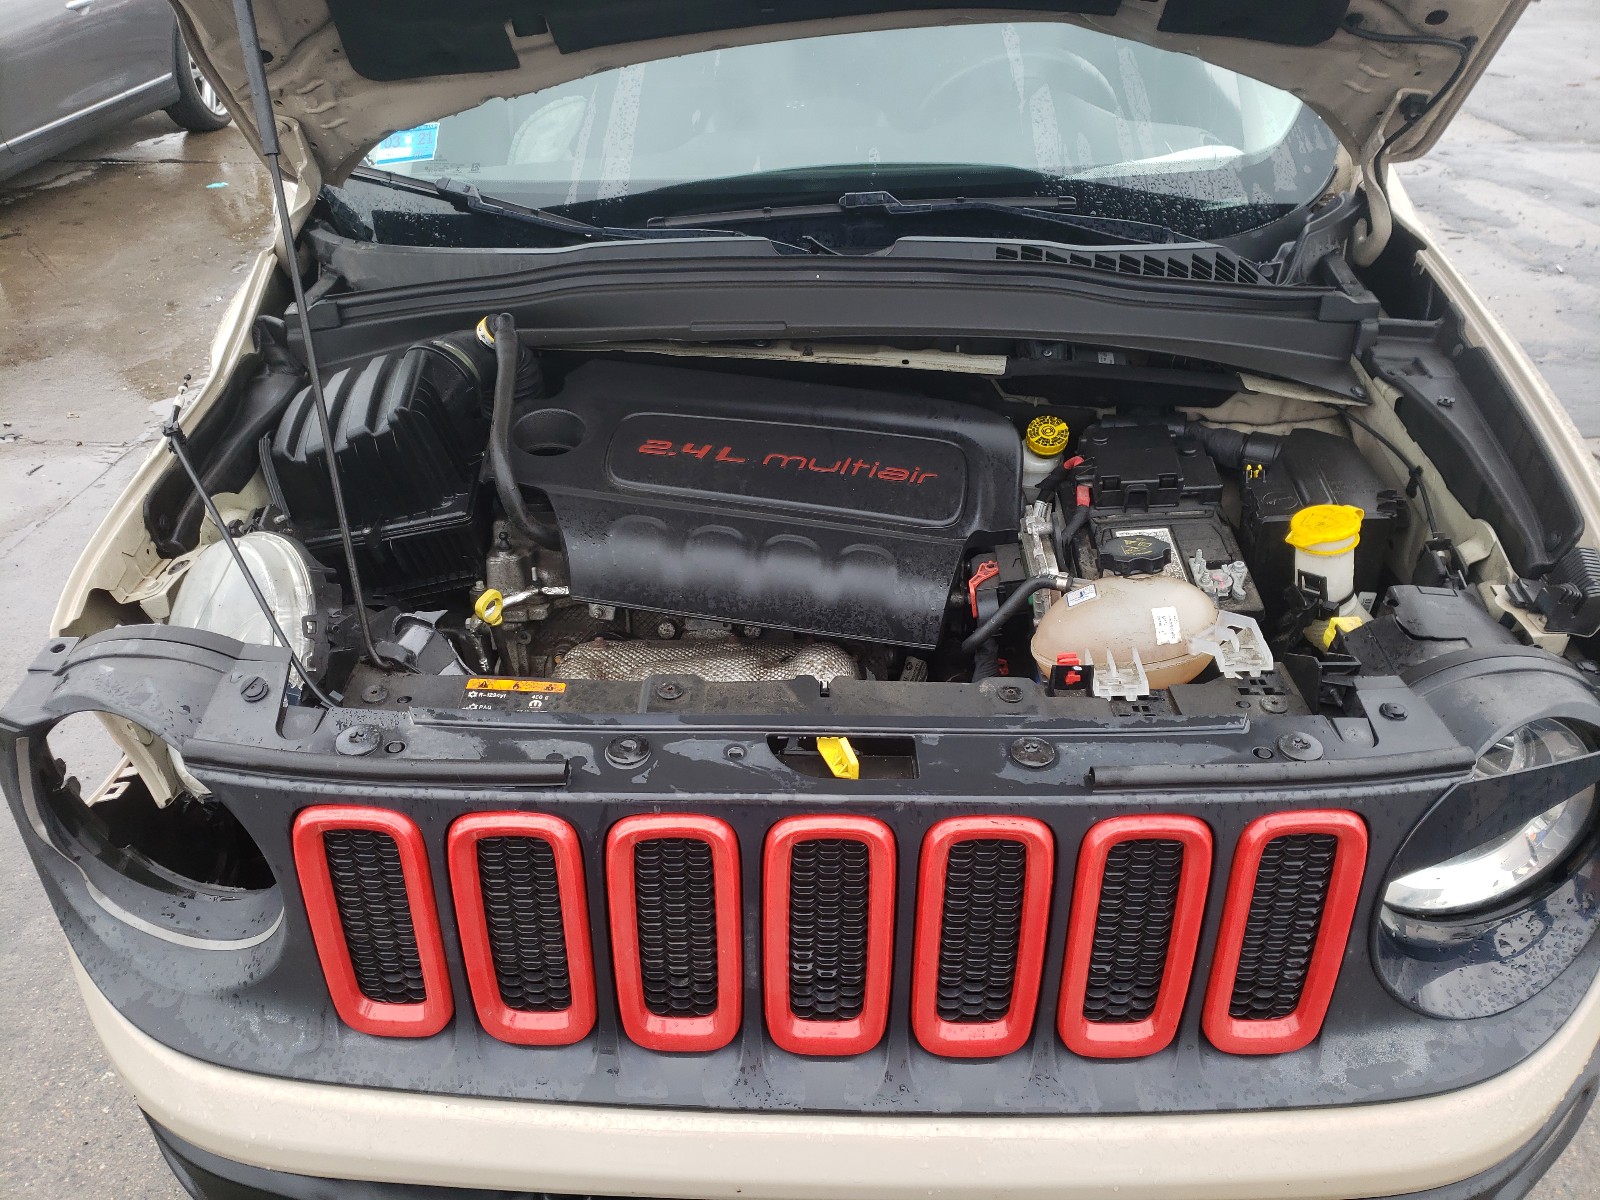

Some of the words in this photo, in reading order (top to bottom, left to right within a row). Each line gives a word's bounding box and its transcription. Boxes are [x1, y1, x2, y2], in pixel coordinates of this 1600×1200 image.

[384, 136, 401, 149] 03
[417, 132, 433, 145] 21
[762, 453, 940, 485] multiair
